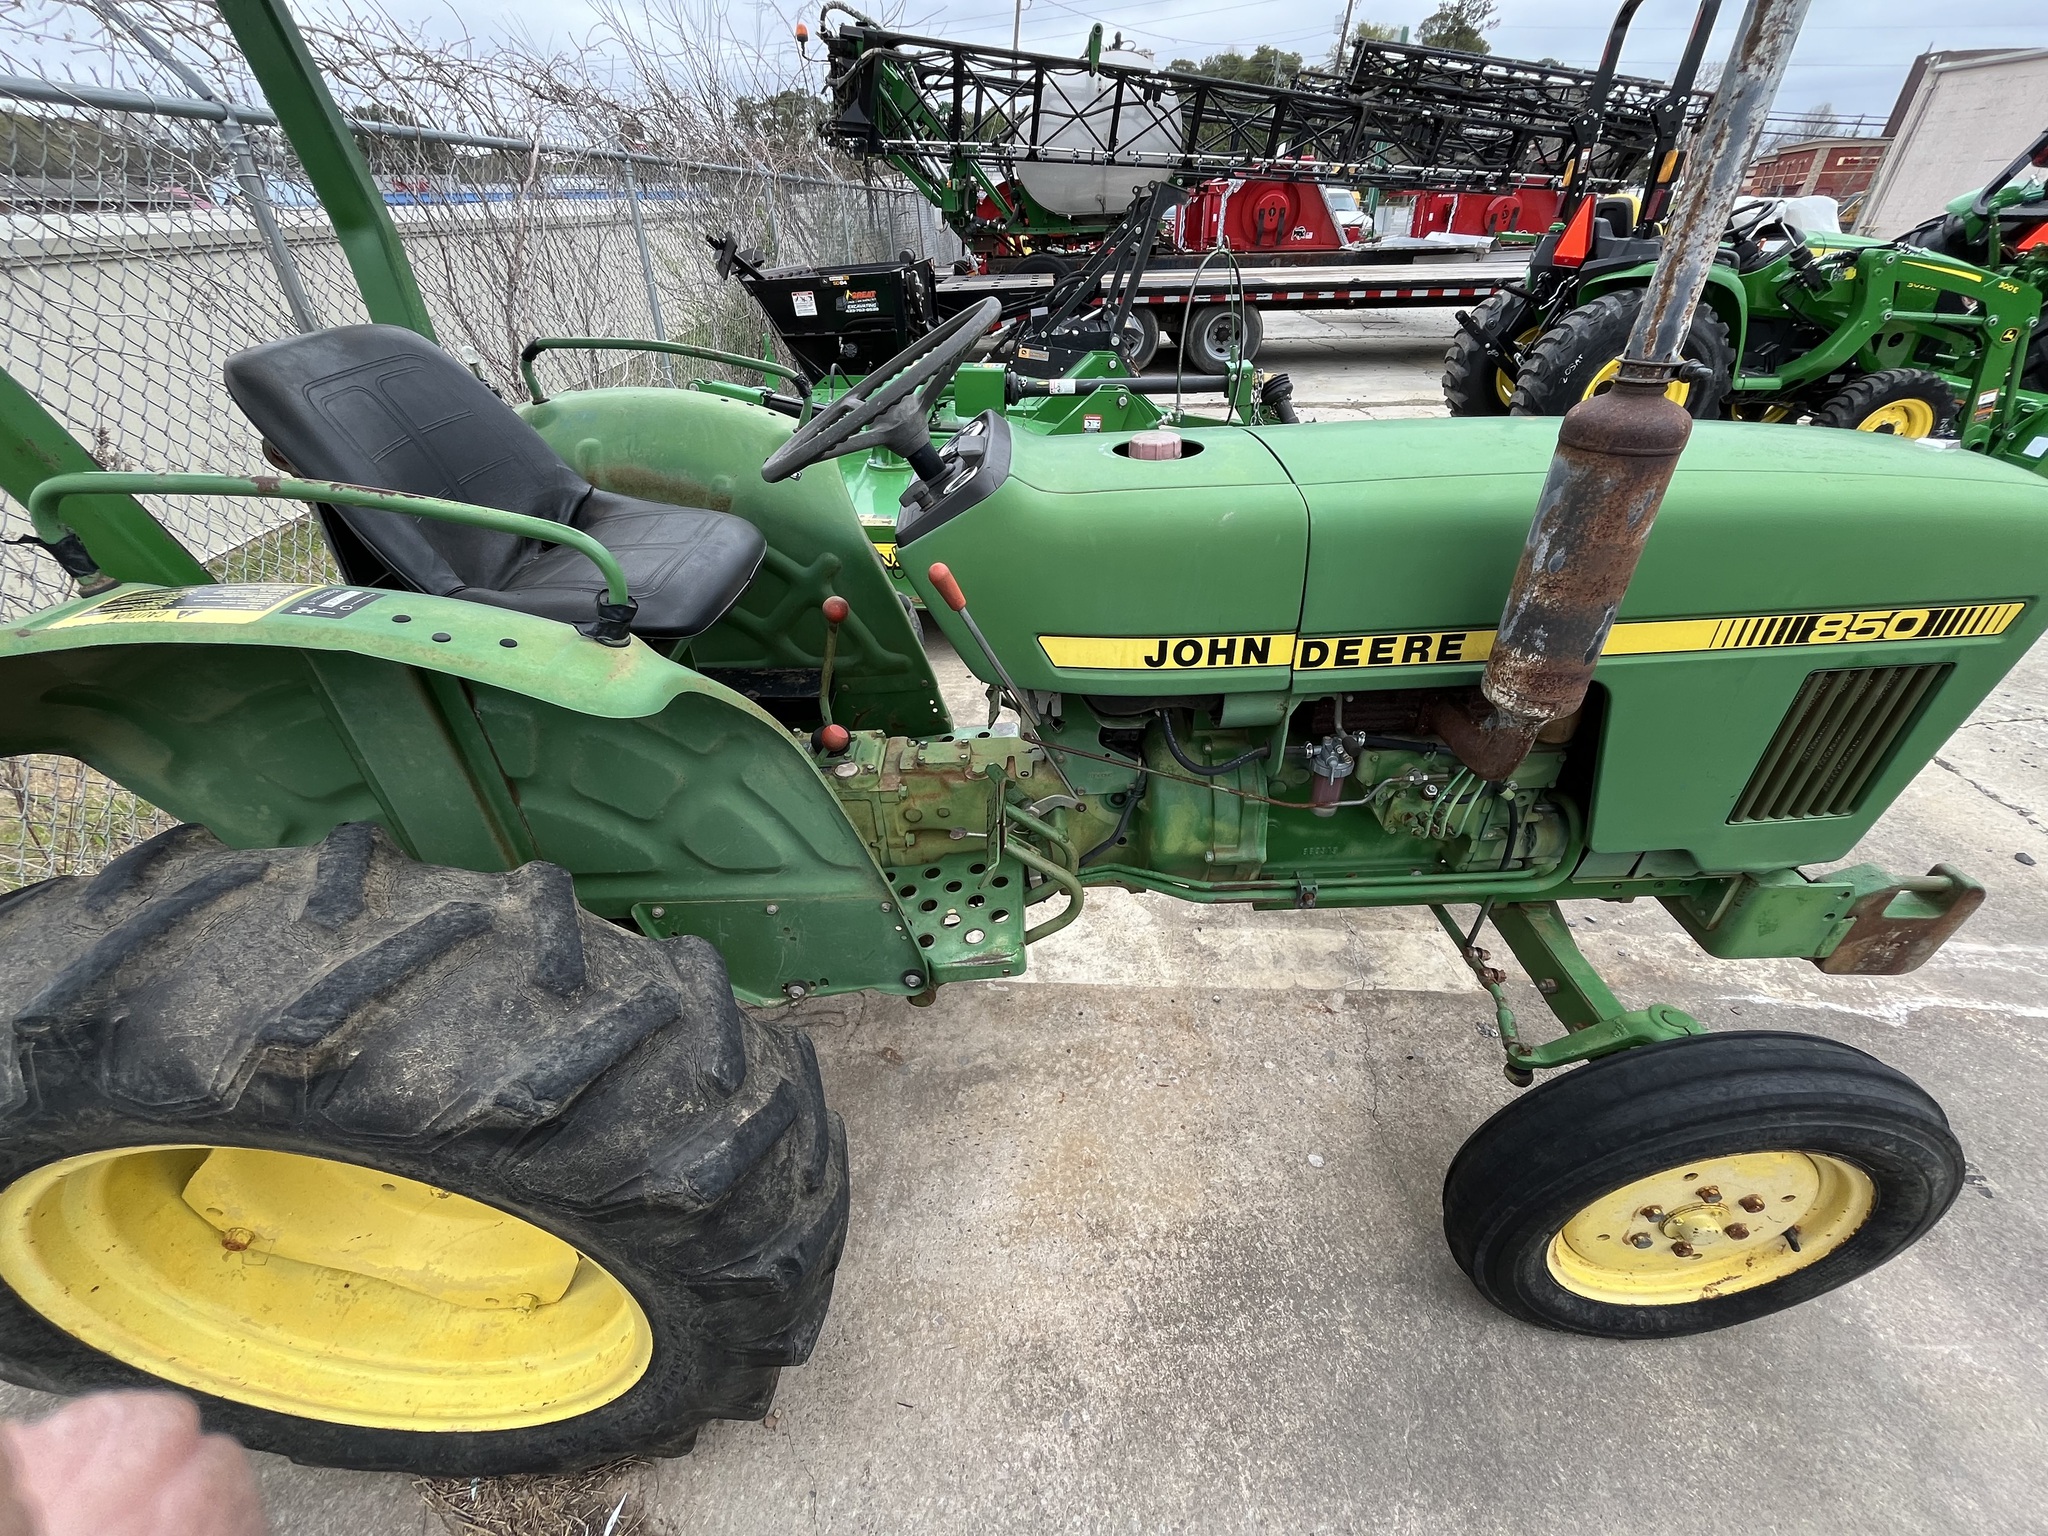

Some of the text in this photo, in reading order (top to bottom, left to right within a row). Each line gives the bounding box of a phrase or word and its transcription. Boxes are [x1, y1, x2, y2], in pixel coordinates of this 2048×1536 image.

[107, 605, 170, 620] CAUTION
[1808, 610, 1930, 643] 850
[1144, 633, 1467, 668] JOHN DEERE
